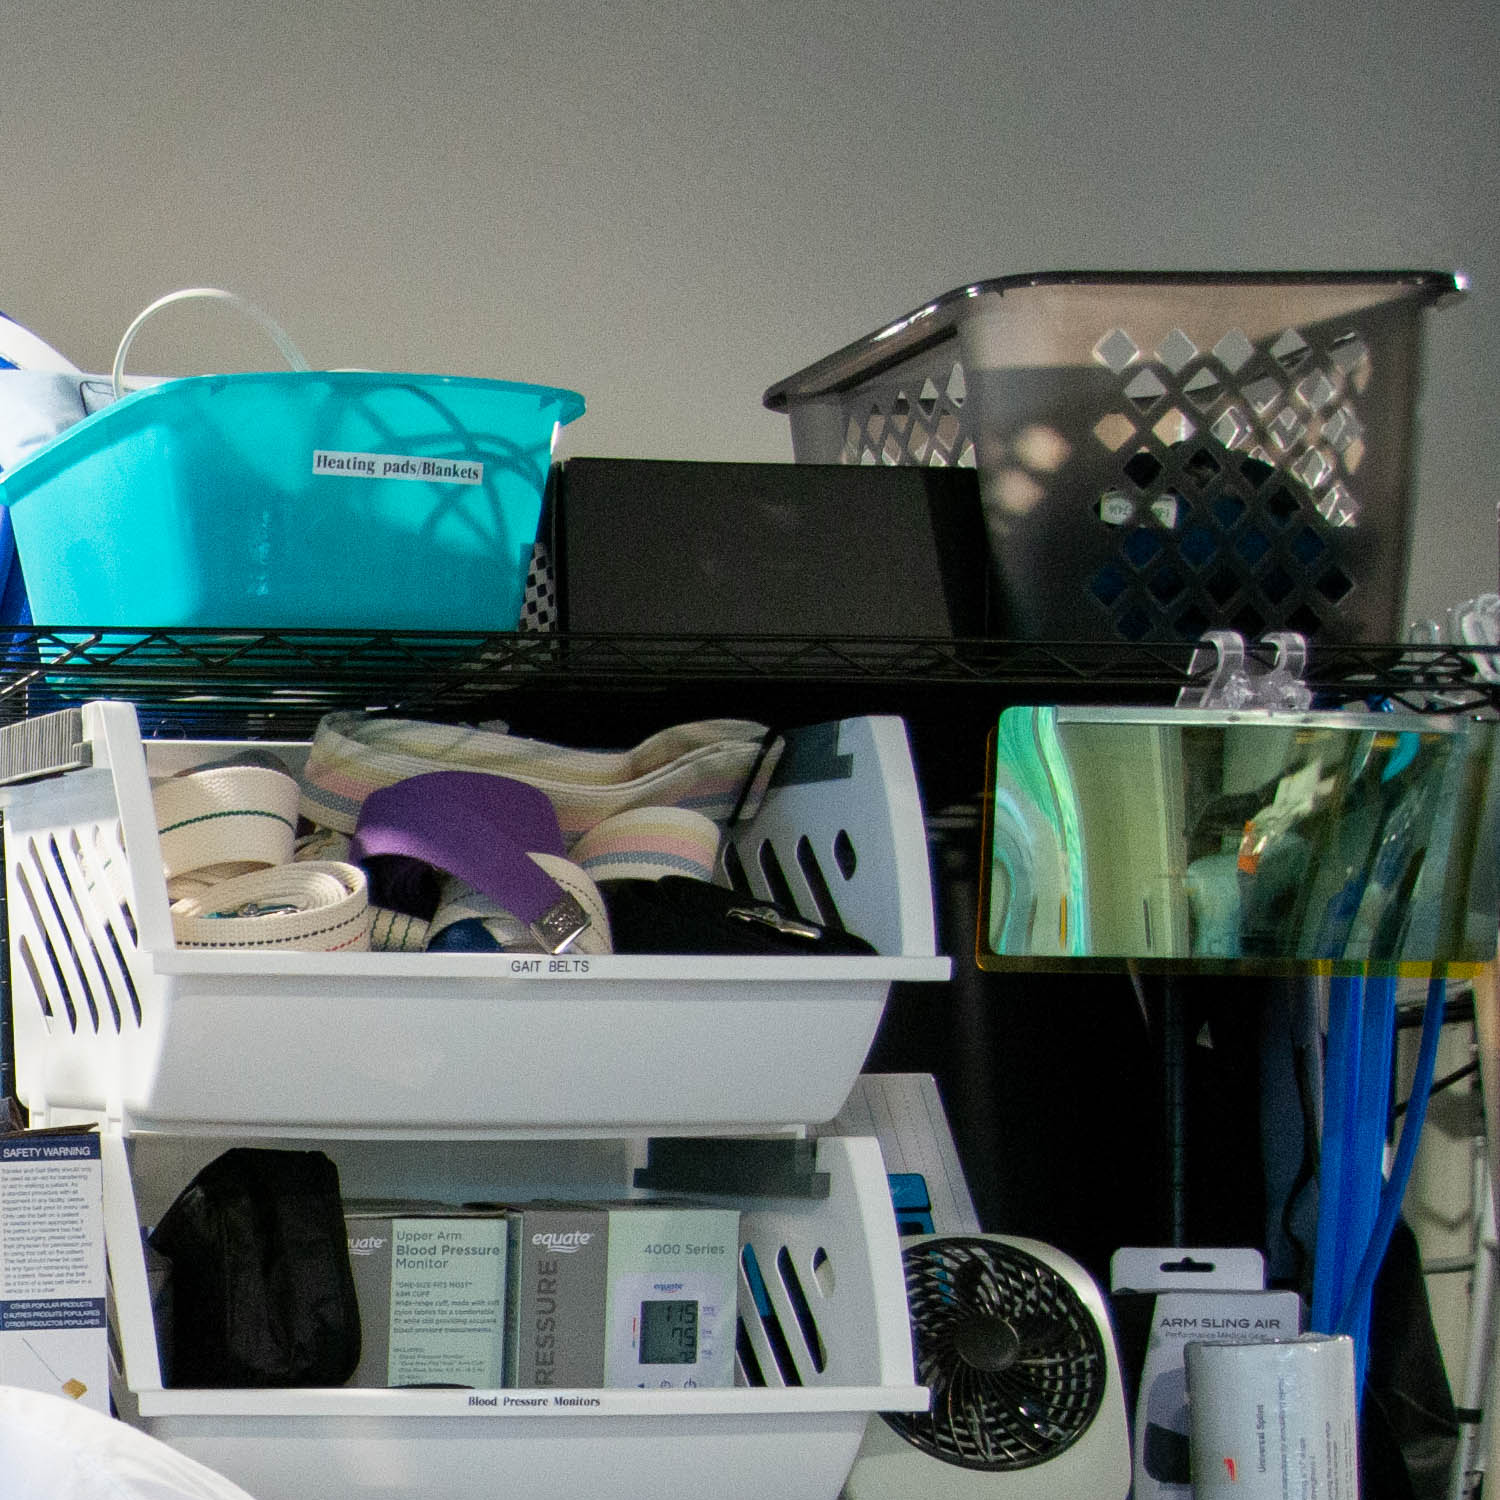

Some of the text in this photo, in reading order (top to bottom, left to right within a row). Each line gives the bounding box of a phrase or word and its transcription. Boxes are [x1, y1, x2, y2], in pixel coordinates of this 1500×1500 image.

[316, 455, 479, 480] Heating pads/Blankets
[511, 960, 589, 973] GAIT BELTS
[3, 1146, 90, 1158] SAFETY WARNING
[397, 1232, 462, 1241] Upper Arm
[532, 1231, 591, 1250] equate
[348, 1236, 383, 1249] uate
[396, 1245, 500, 1256] Blood Pressure
[645, 1244, 725, 1254] 4000 Series
[396, 1258, 448, 1269] Monitor
[665, 1303, 696, 1323] 115
[1160, 1318, 1280, 1328] ARM SLING AIR
[468, 1397, 601, 1406] Blood Pressure Monitors
